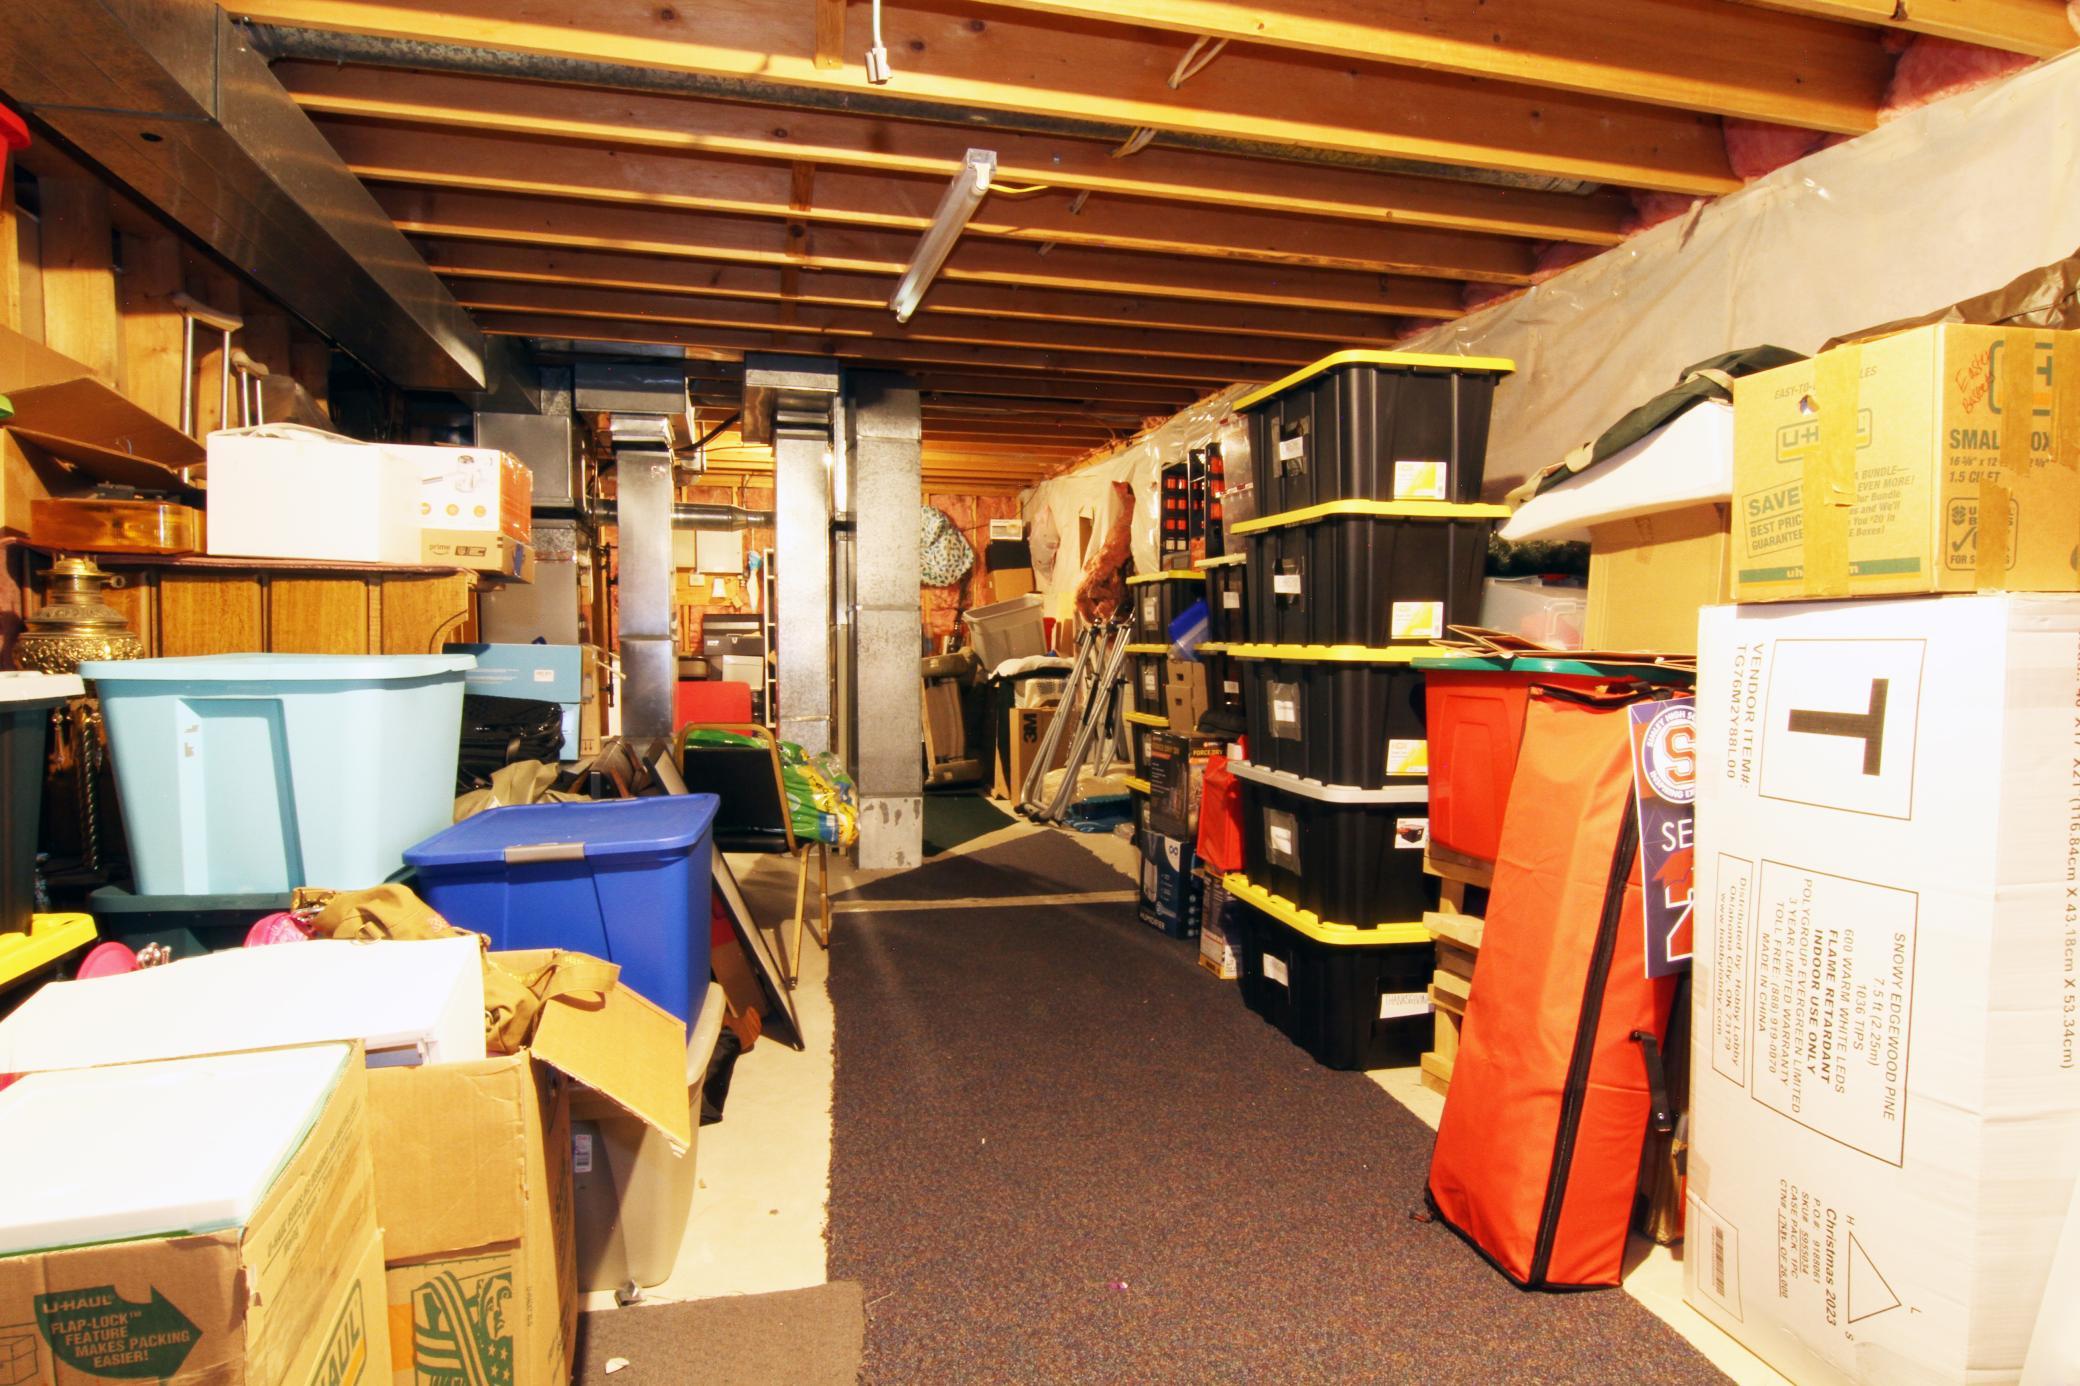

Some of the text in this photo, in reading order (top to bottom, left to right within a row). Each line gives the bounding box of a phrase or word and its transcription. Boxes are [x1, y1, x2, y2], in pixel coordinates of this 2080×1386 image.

[1774, 382, 1815, 400] EASY-TO-
[1949, 429, 2000, 450] SMAL
[1858, 476, 1915, 492] EVEN MORE!
[1949, 472, 1965, 482] 1.5
[1748, 486, 1803, 517] SAVE
[1871, 491, 1901, 499] Bundle
[1879, 502, 1900, 511] We'll
[1751, 515, 1803, 537] BEST PRIC
[1854, 517, 1867, 525] You
[1856, 526, 1885, 536] Boxes!
[1752, 529, 1803, 551] GUARANTEE
[1743, 643, 1764, 723] VENDOR
[1023, 713, 1038, 744] 3M
[1664, 710, 1686, 722] HIGH
[1788, 678, 1888, 776] T
[2067, 887, 2078, 897] X
[1727, 886, 1737, 952] Oklahoma
[1736, 877, 1747, 950] Distributed
[1774, 901, 1784, 935] TOLL
[1786, 910, 1796, 946] YEAR
[2064, 903, 2077, 972] 43.18cm
[1716, 893, 1726, 1036] www.hobbylobby.com
[1784, 951, 1794, 1003] LIMITED
[1725, 989, 1733, 1008] OK
[1758, 933, 1769, 1032] MADE IN CHINA
[1770, 983, 1780, 1014] (888)
[1791, 879, 1812, 1113] POLYGROUP EVERGREEN LIMITED
[2064, 978, 2076, 989] X
[1733, 979, 1743, 1021] Hobby
[1807, 930, 1823, 1075] INDOOR USE ONLY
[1821, 930, 1838, 1084] FLAME RETARDANT
[1835, 929, 1854, 1094] 600 WARM WHITE LEDS
[1853, 984, 1867, 1050] 1036 TIPS
[1868, 977, 1885, 1066] 7.5 ft (2.25m)
[1883, 933, 1906, 1121] SNOWY EDGEWOOD PINE
[2060, 995, 2075, 1069] 53.34cm)
[1732, 1026, 1741, 1066] Lobby
[1769, 1018, 1778, 1073] 919-0070
[1780, 1009, 1791, 1087] WARRANTY
[1846, 1215, 1855, 1226] H
[1781, 1247, 1788, 1261] OF
[1825, 1208, 1837, 1326] Christmas 2023
[65, 1327, 129, 1346] FEATURE
[75, 1330, 190, 1358] MAKES PACKING
[1845, 1331, 1854, 1341] S
[94, 1351, 149, 1369] EASIER!
